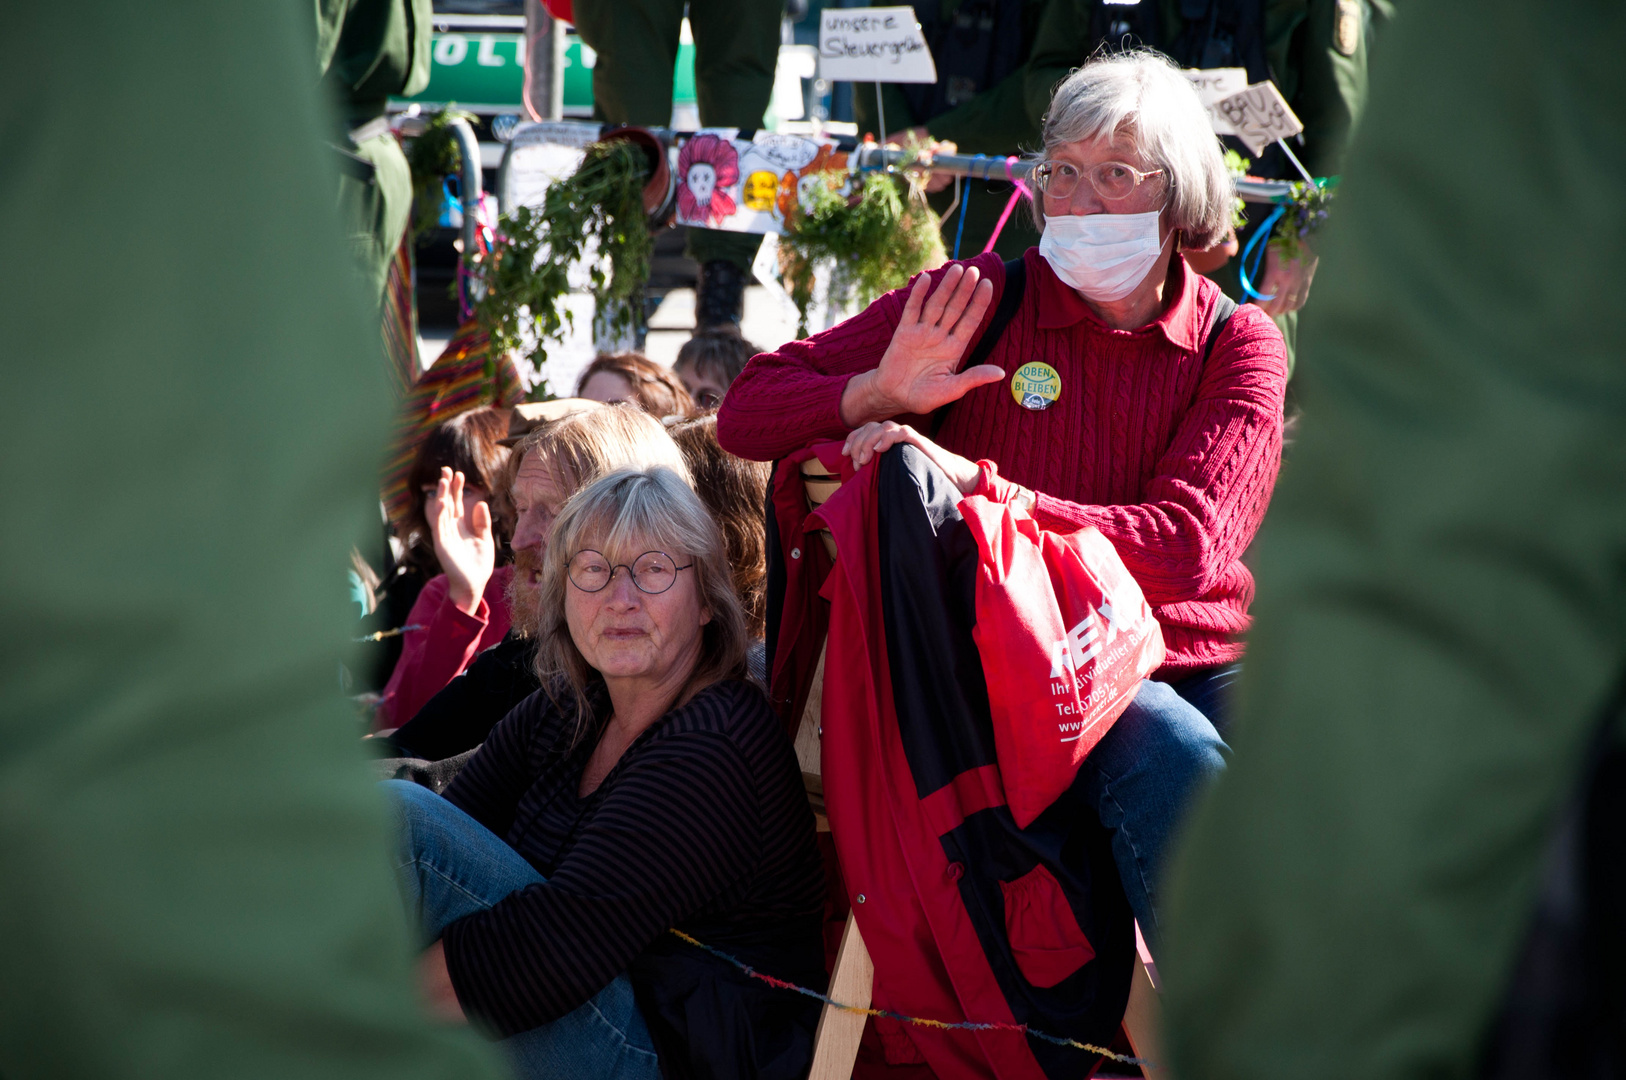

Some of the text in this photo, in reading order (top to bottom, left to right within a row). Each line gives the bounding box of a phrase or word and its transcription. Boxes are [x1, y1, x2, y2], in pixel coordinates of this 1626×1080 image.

[826, 15, 898, 33] unsere
[1023, 366, 1051, 377] OBEN
[1014, 381, 1057, 394] BLEIBEN
[1051, 683, 1071, 696] Ihr
